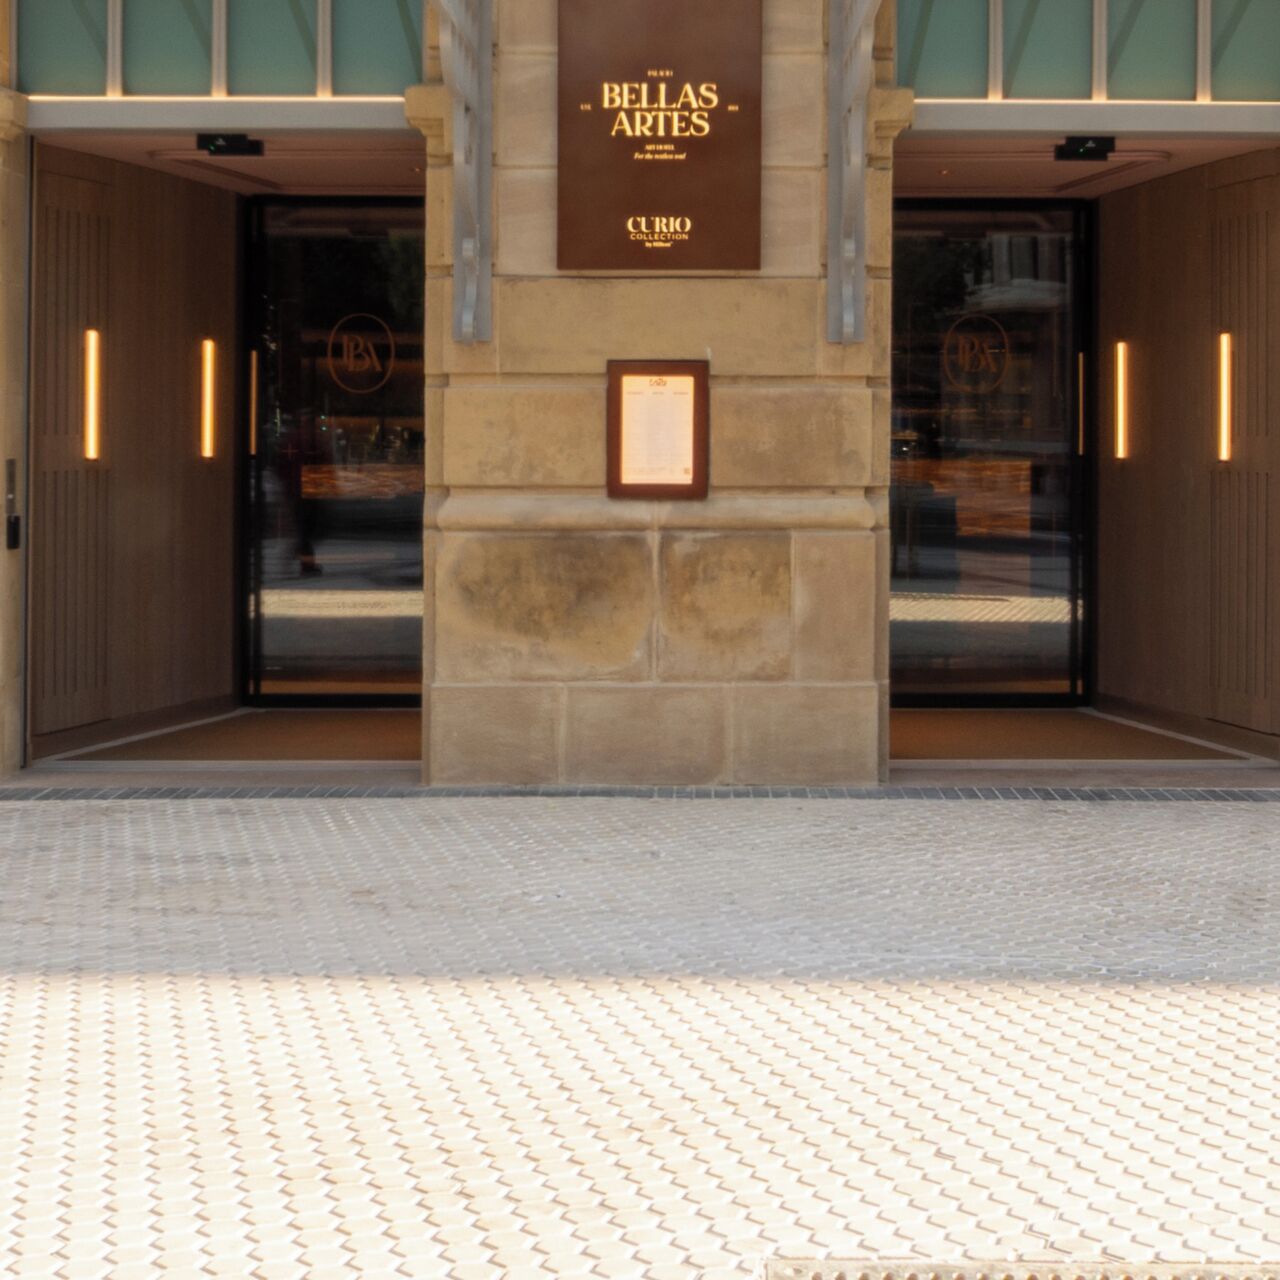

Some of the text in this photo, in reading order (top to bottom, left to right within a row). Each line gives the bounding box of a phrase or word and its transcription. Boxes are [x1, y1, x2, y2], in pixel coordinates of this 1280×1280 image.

[602, 82, 719, 109] BELLAS
[610, 111, 711, 136] ARTES
[626, 216, 692, 232] CURIO
[630, 233, 689, 241] COLLECTION
